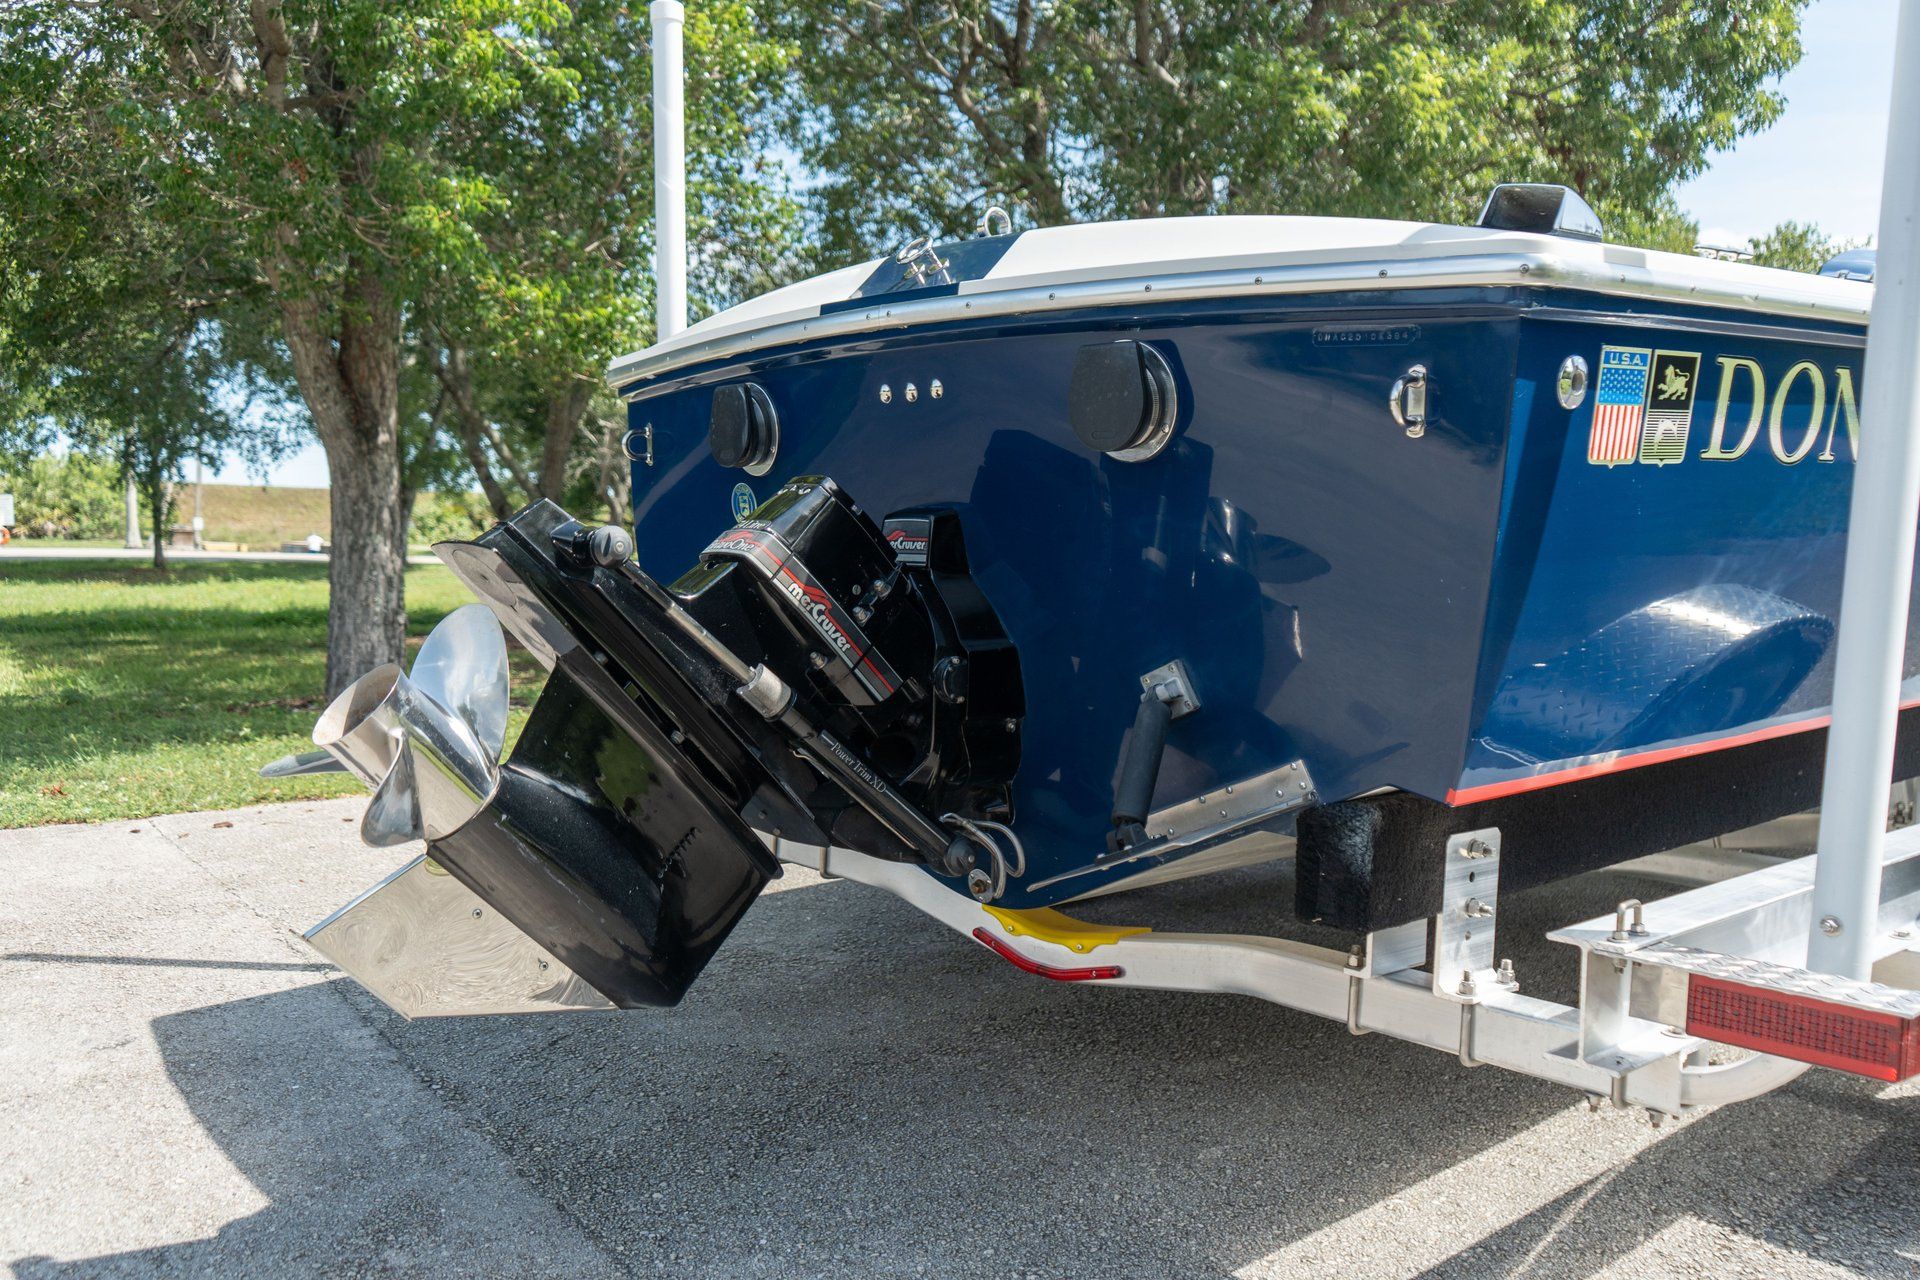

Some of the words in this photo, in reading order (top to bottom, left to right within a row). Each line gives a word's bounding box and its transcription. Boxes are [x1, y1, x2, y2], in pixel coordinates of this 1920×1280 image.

[889, 536, 926, 550] erCruiser
[831, 742, 855, 766] Power
[853, 760, 872, 783] Trim
